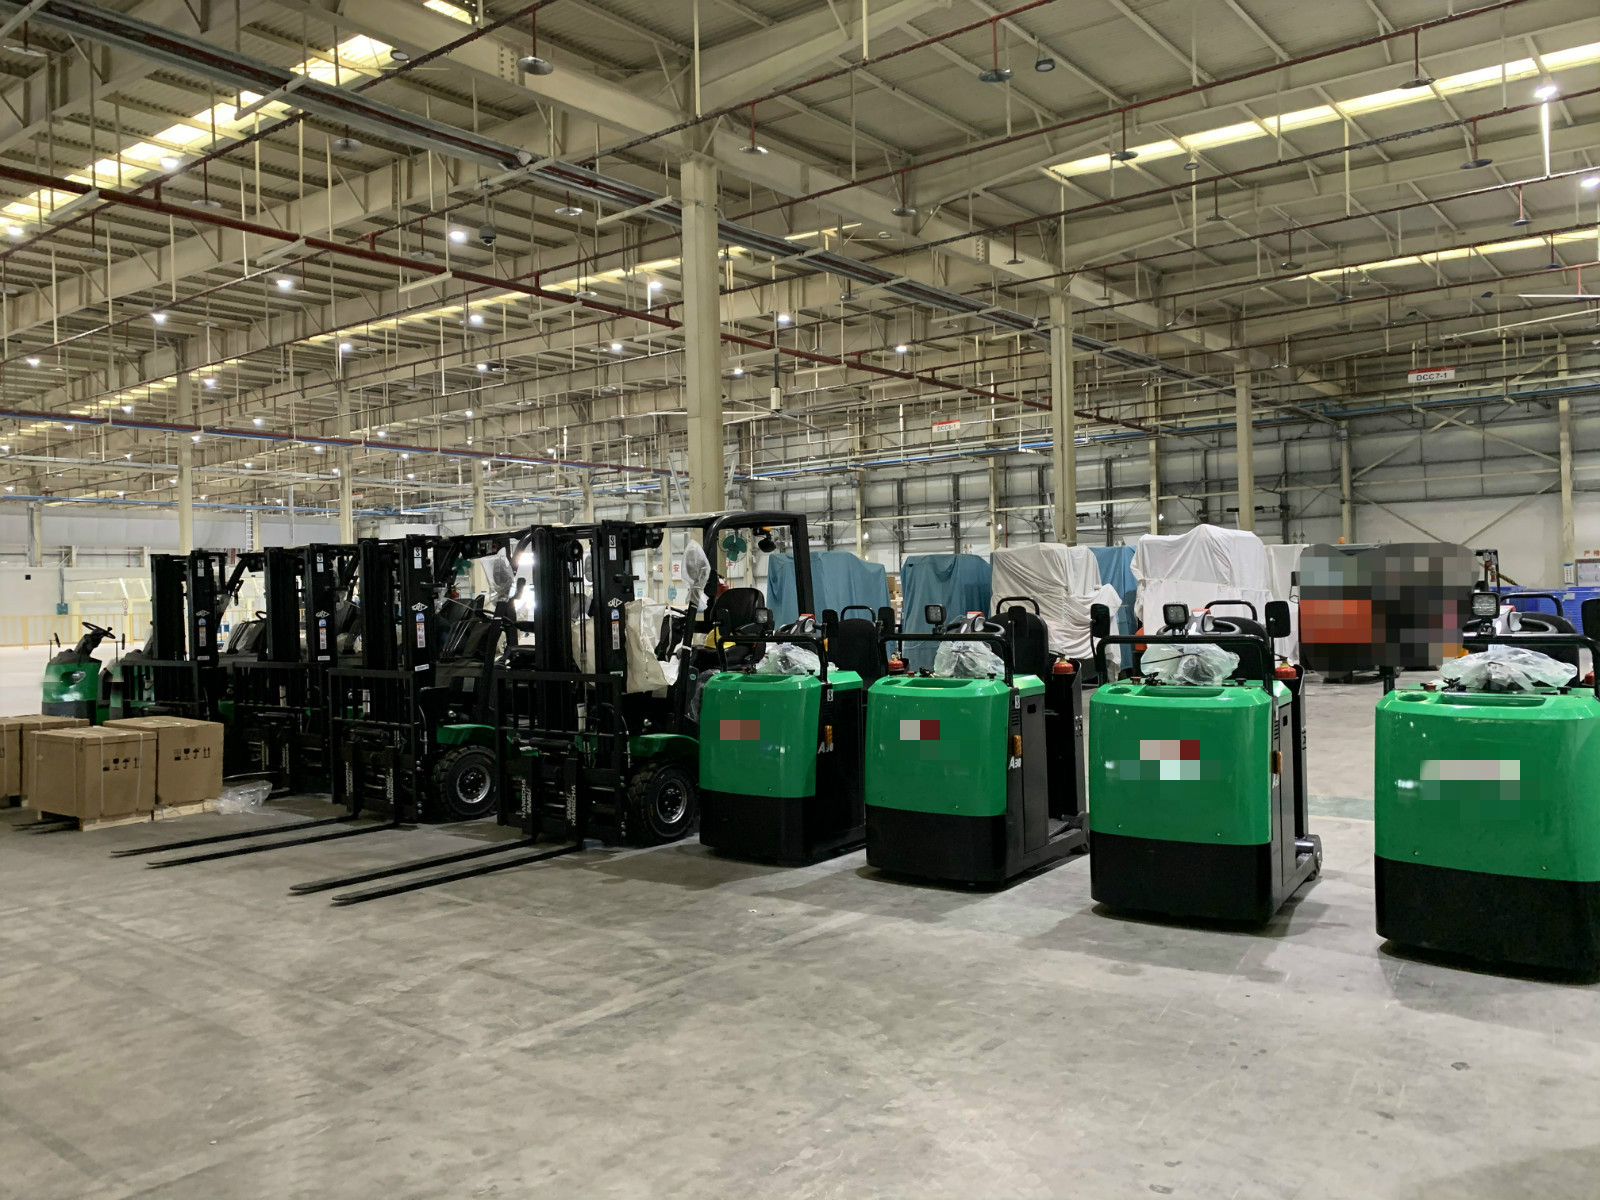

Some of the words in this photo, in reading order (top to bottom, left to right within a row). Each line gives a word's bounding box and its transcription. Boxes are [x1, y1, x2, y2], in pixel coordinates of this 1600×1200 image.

[1416, 372, 1447, 381] DCC7-1
[818, 742, 834, 754] A30
[1008, 756, 1021, 769] A30
